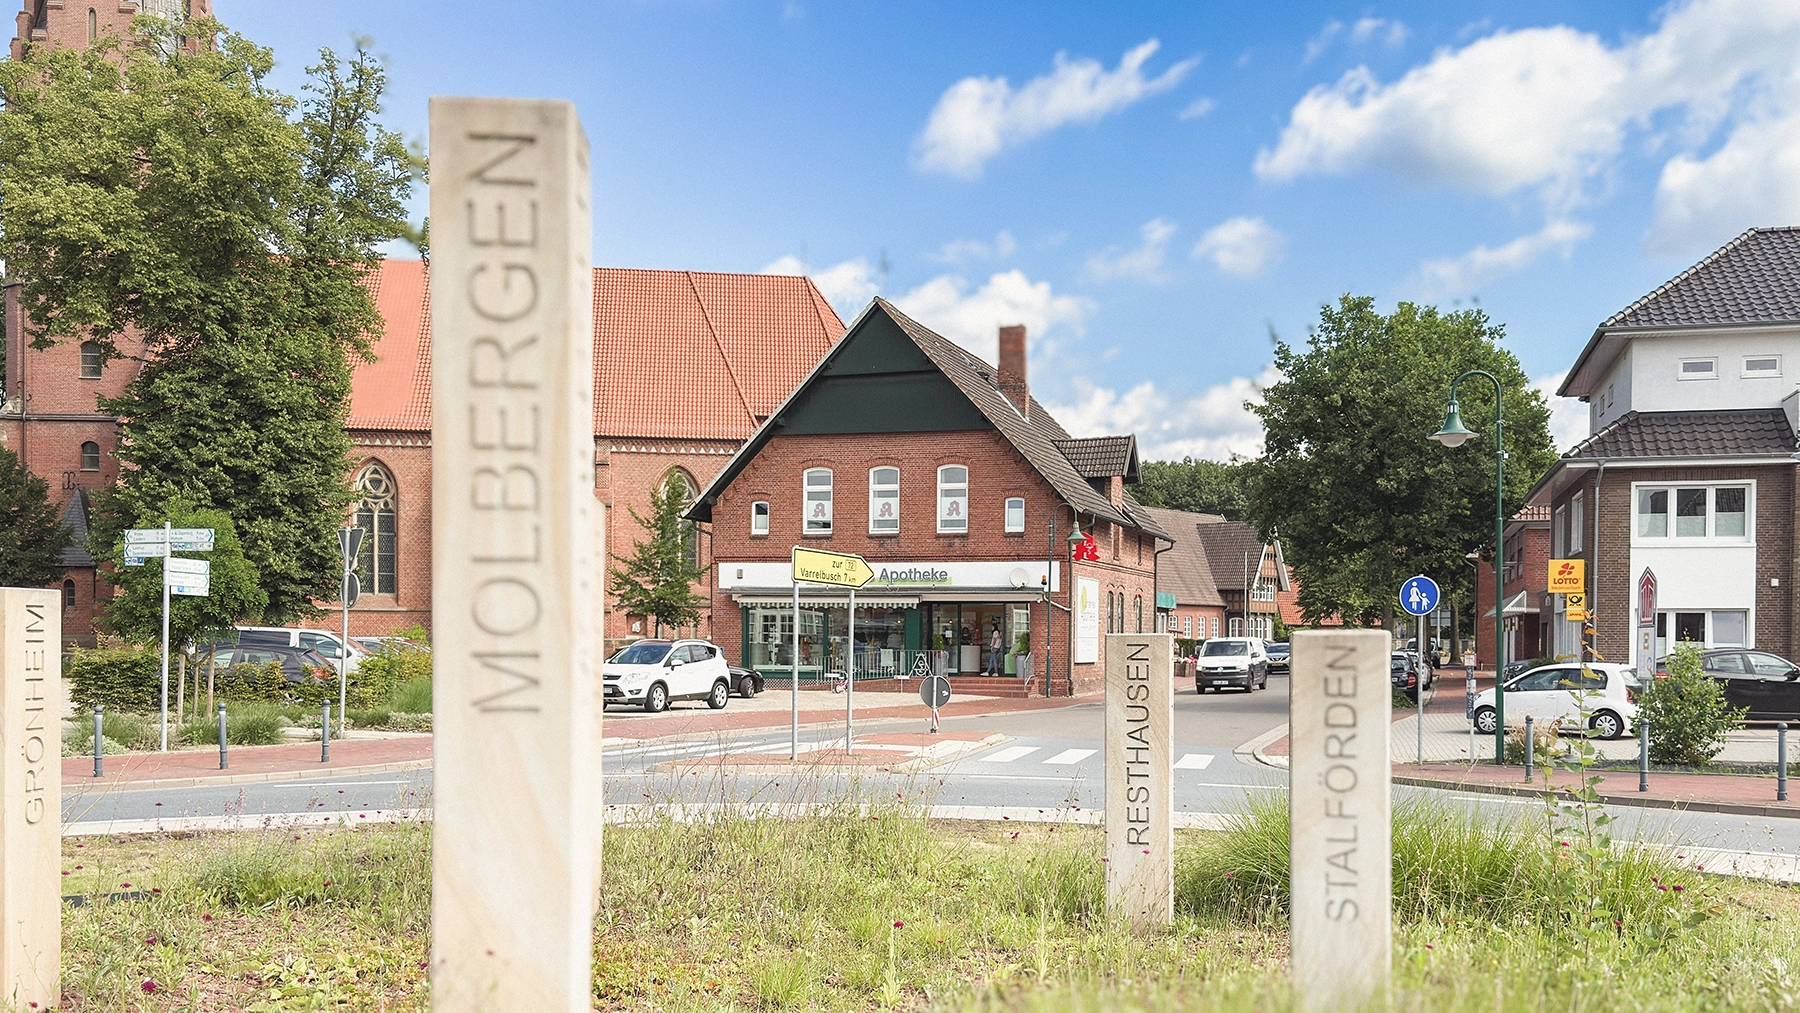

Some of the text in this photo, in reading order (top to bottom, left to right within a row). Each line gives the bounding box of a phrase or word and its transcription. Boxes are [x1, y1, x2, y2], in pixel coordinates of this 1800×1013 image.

[465, 130, 541, 713] MOLBERGEN
[800, 567, 842, 582] Varrelbusch
[843, 572, 848, 582] 7
[832, 560, 855, 570] zur 72
[879, 567, 948, 583] Apotheke
[21, 604, 45, 826] GRÖNHEIM
[1126, 643, 1150, 846] RESTHAUSEN
[1318, 644, 1360, 922] STALFÖRDEN
